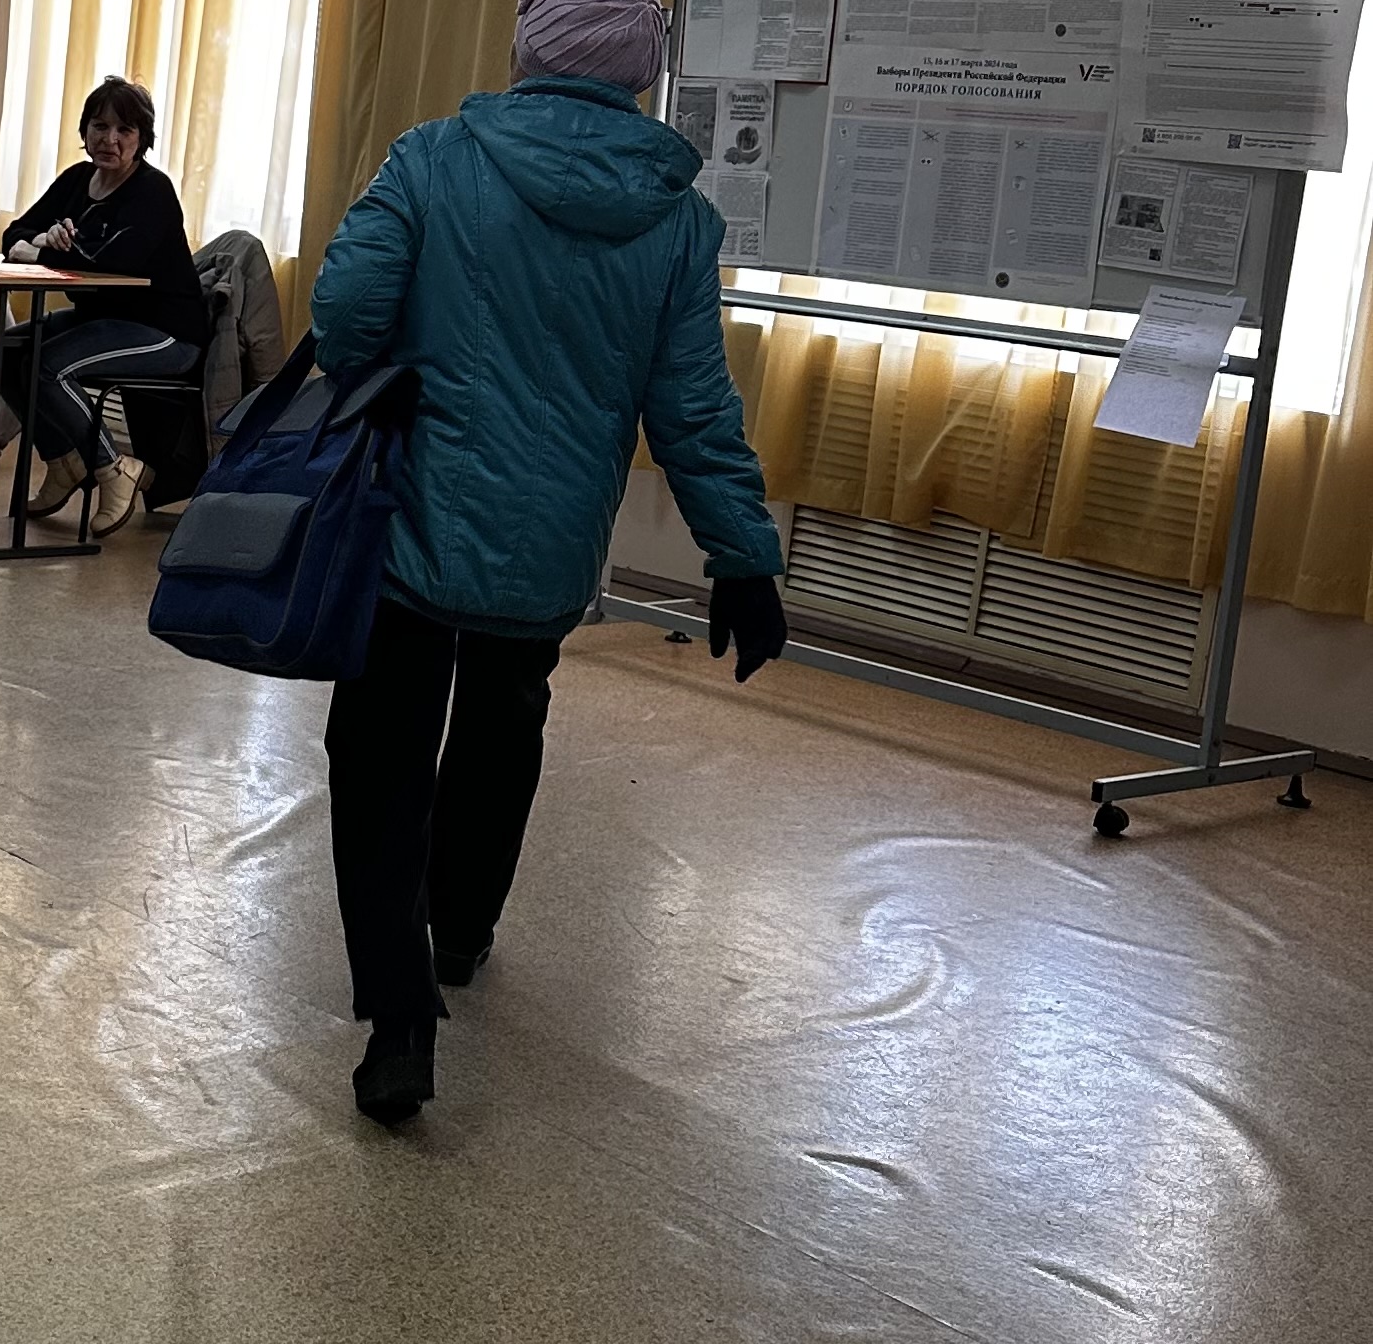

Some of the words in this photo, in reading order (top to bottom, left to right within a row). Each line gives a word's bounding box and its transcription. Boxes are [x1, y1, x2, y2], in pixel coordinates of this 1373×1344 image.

[960, 60, 982, 69] марта
[876, 66, 911, 77] Выборы
[912, 67, 962, 80] Президента
[964, 69, 1014, 82] Российской
[1015, 71, 1066, 85] Федерации
[894, 82, 948, 95] ПОРЯДОК
[951, 85, 1042, 100] ГОЛОСОВАНИЯ
[731, 94, 765, 103] ПАМЯТКА
